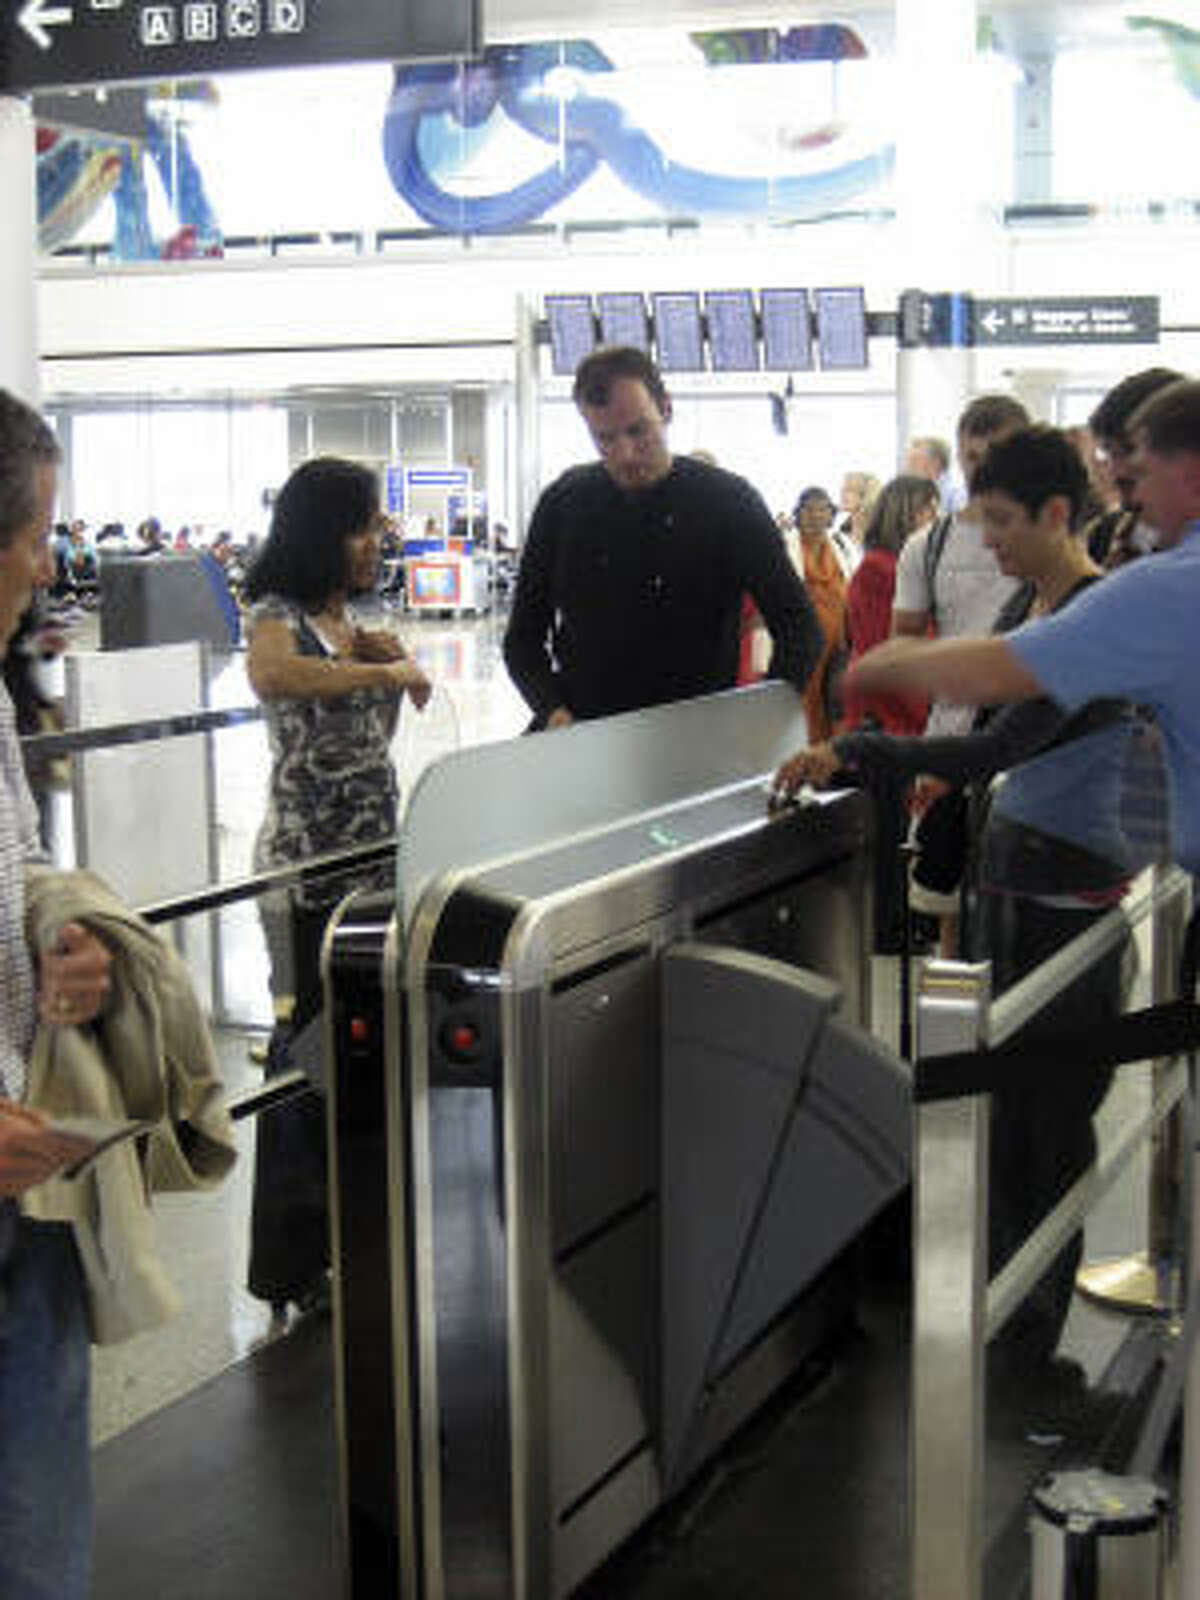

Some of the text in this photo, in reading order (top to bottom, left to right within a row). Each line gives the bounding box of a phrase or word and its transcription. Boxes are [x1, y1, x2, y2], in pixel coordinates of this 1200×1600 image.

[147, 11, 171, 41] A
[230, 3, 254, 34] C
[274, 1, 298, 30] D
